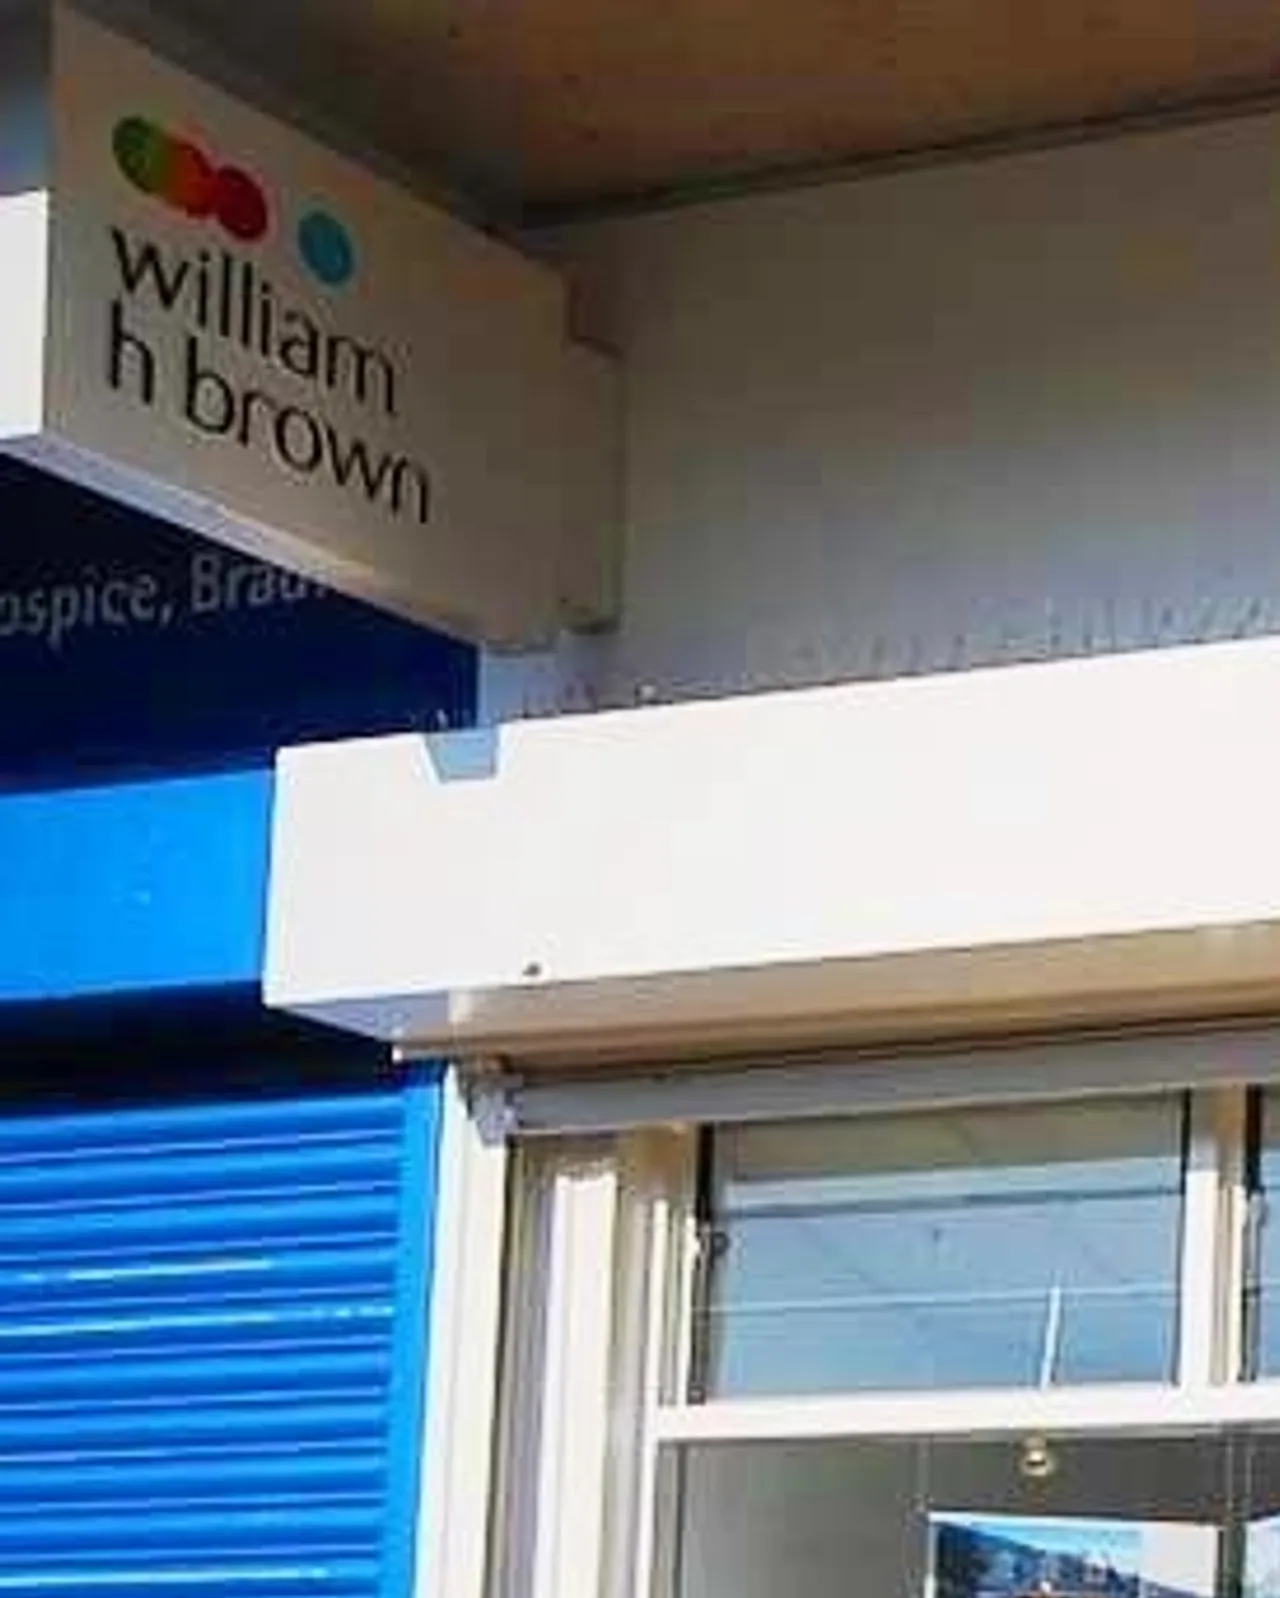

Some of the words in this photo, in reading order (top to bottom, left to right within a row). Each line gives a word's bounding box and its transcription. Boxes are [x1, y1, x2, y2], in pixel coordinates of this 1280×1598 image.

[109, 301, 155, 406] h
[185, 335, 430, 524] brown
[112, 226, 398, 414] william
[190, 552, 326, 612] Bra
